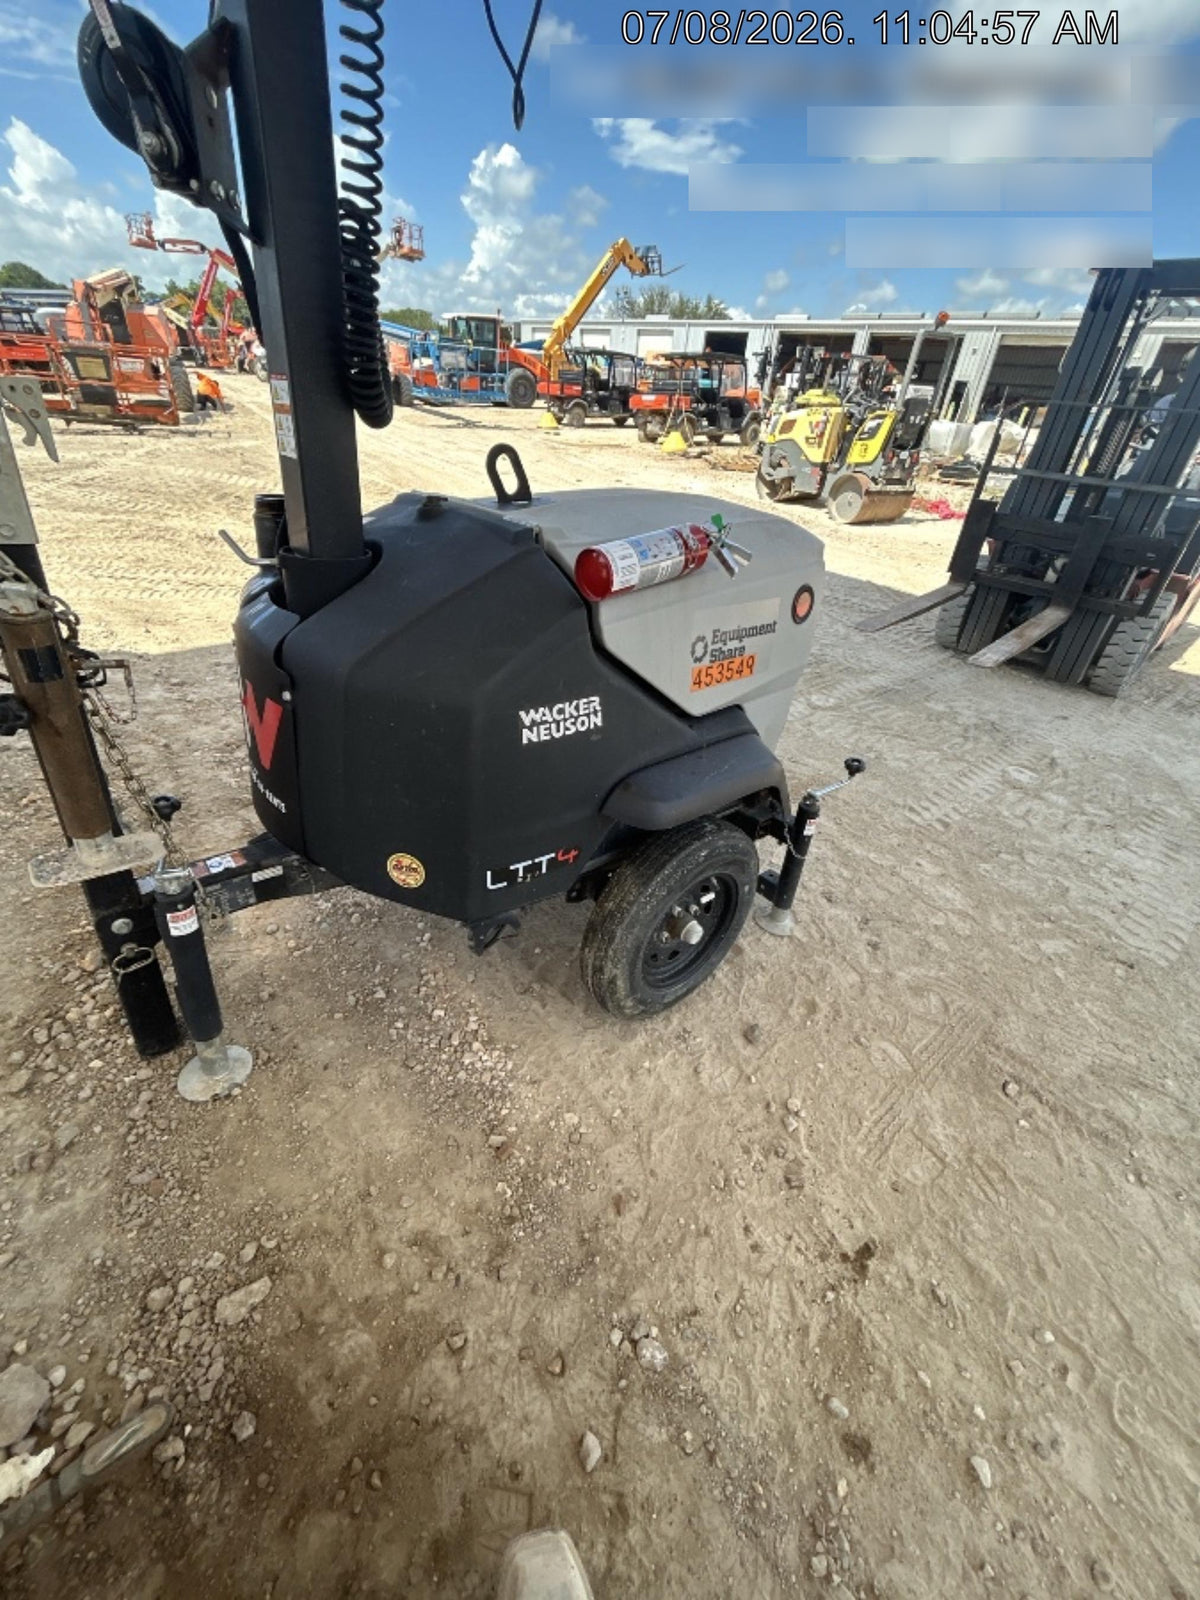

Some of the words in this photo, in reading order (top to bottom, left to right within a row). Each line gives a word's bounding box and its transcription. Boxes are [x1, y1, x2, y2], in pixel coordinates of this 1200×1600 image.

[711, 620, 777, 646] Equipment
[709, 645, 746, 663] Share
[693, 655, 755, 688] 453549
[519, 696, 602, 726] WACKER
[522, 711, 603, 745] NEUSON
